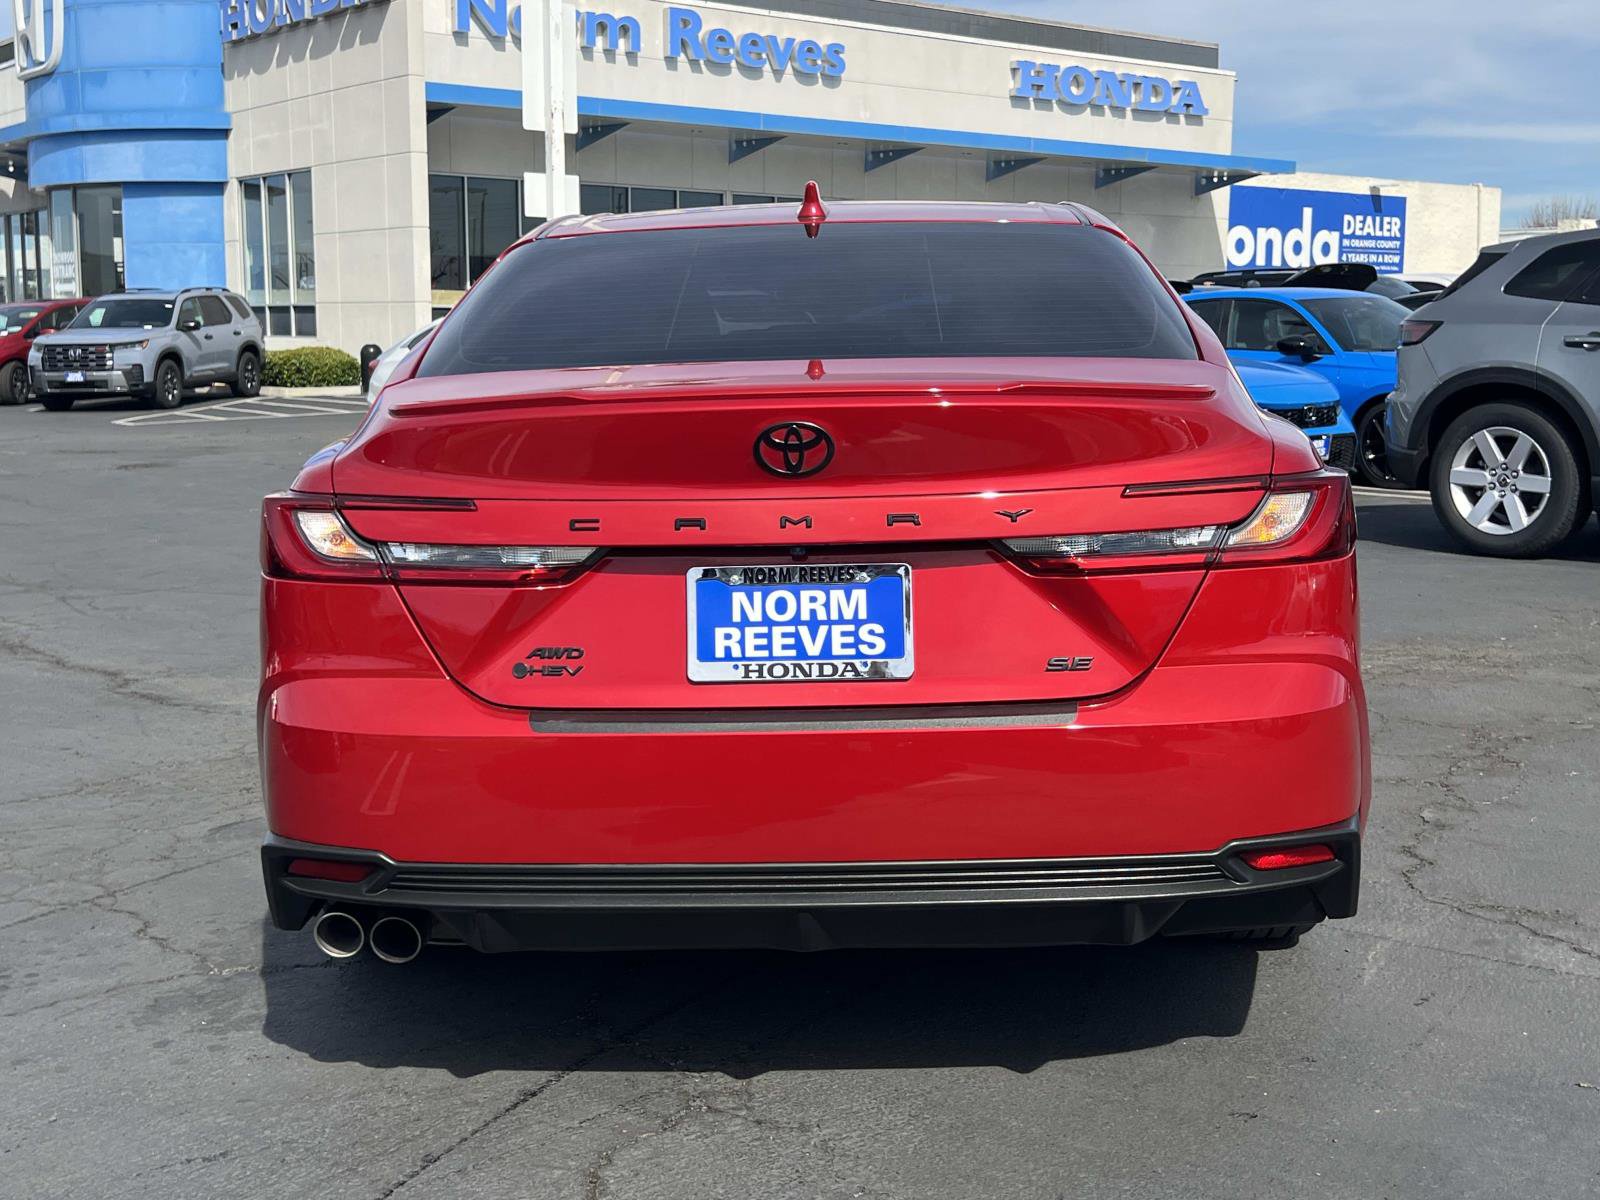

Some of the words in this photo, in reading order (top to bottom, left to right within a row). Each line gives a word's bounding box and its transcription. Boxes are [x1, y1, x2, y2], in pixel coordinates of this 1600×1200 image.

[221, 0, 371, 43] HON
[453, 0, 641, 52] Nm
[663, 7, 846, 77] Reeves
[1010, 61, 1209, 116] HONDA
[1343, 214, 1401, 238] DEALER
[1342, 238, 1350, 247] IN
[1351, 239, 1376, 248] ORANGE
[1377, 240, 1400, 249] COUNTY
[1341, 253, 1347, 262] 4
[1348, 253, 1368, 263] YEARS
[1369, 254, 1377, 263] IN
[1378, 254, 1384, 263] A
[1384, 254, 1400, 263] ROW
[569, 509, 1034, 531] CAMRY
[742, 567, 792, 584] NORM
[799, 565, 856, 583] REEVES
[731, 589, 868, 623] NORM
[714, 623, 887, 659] REEVES
[526, 647, 584, 660] AWD
[528, 664, 584, 677] HEV
[741, 661, 863, 679] HONDA
[1044, 656, 1094, 672] SE
